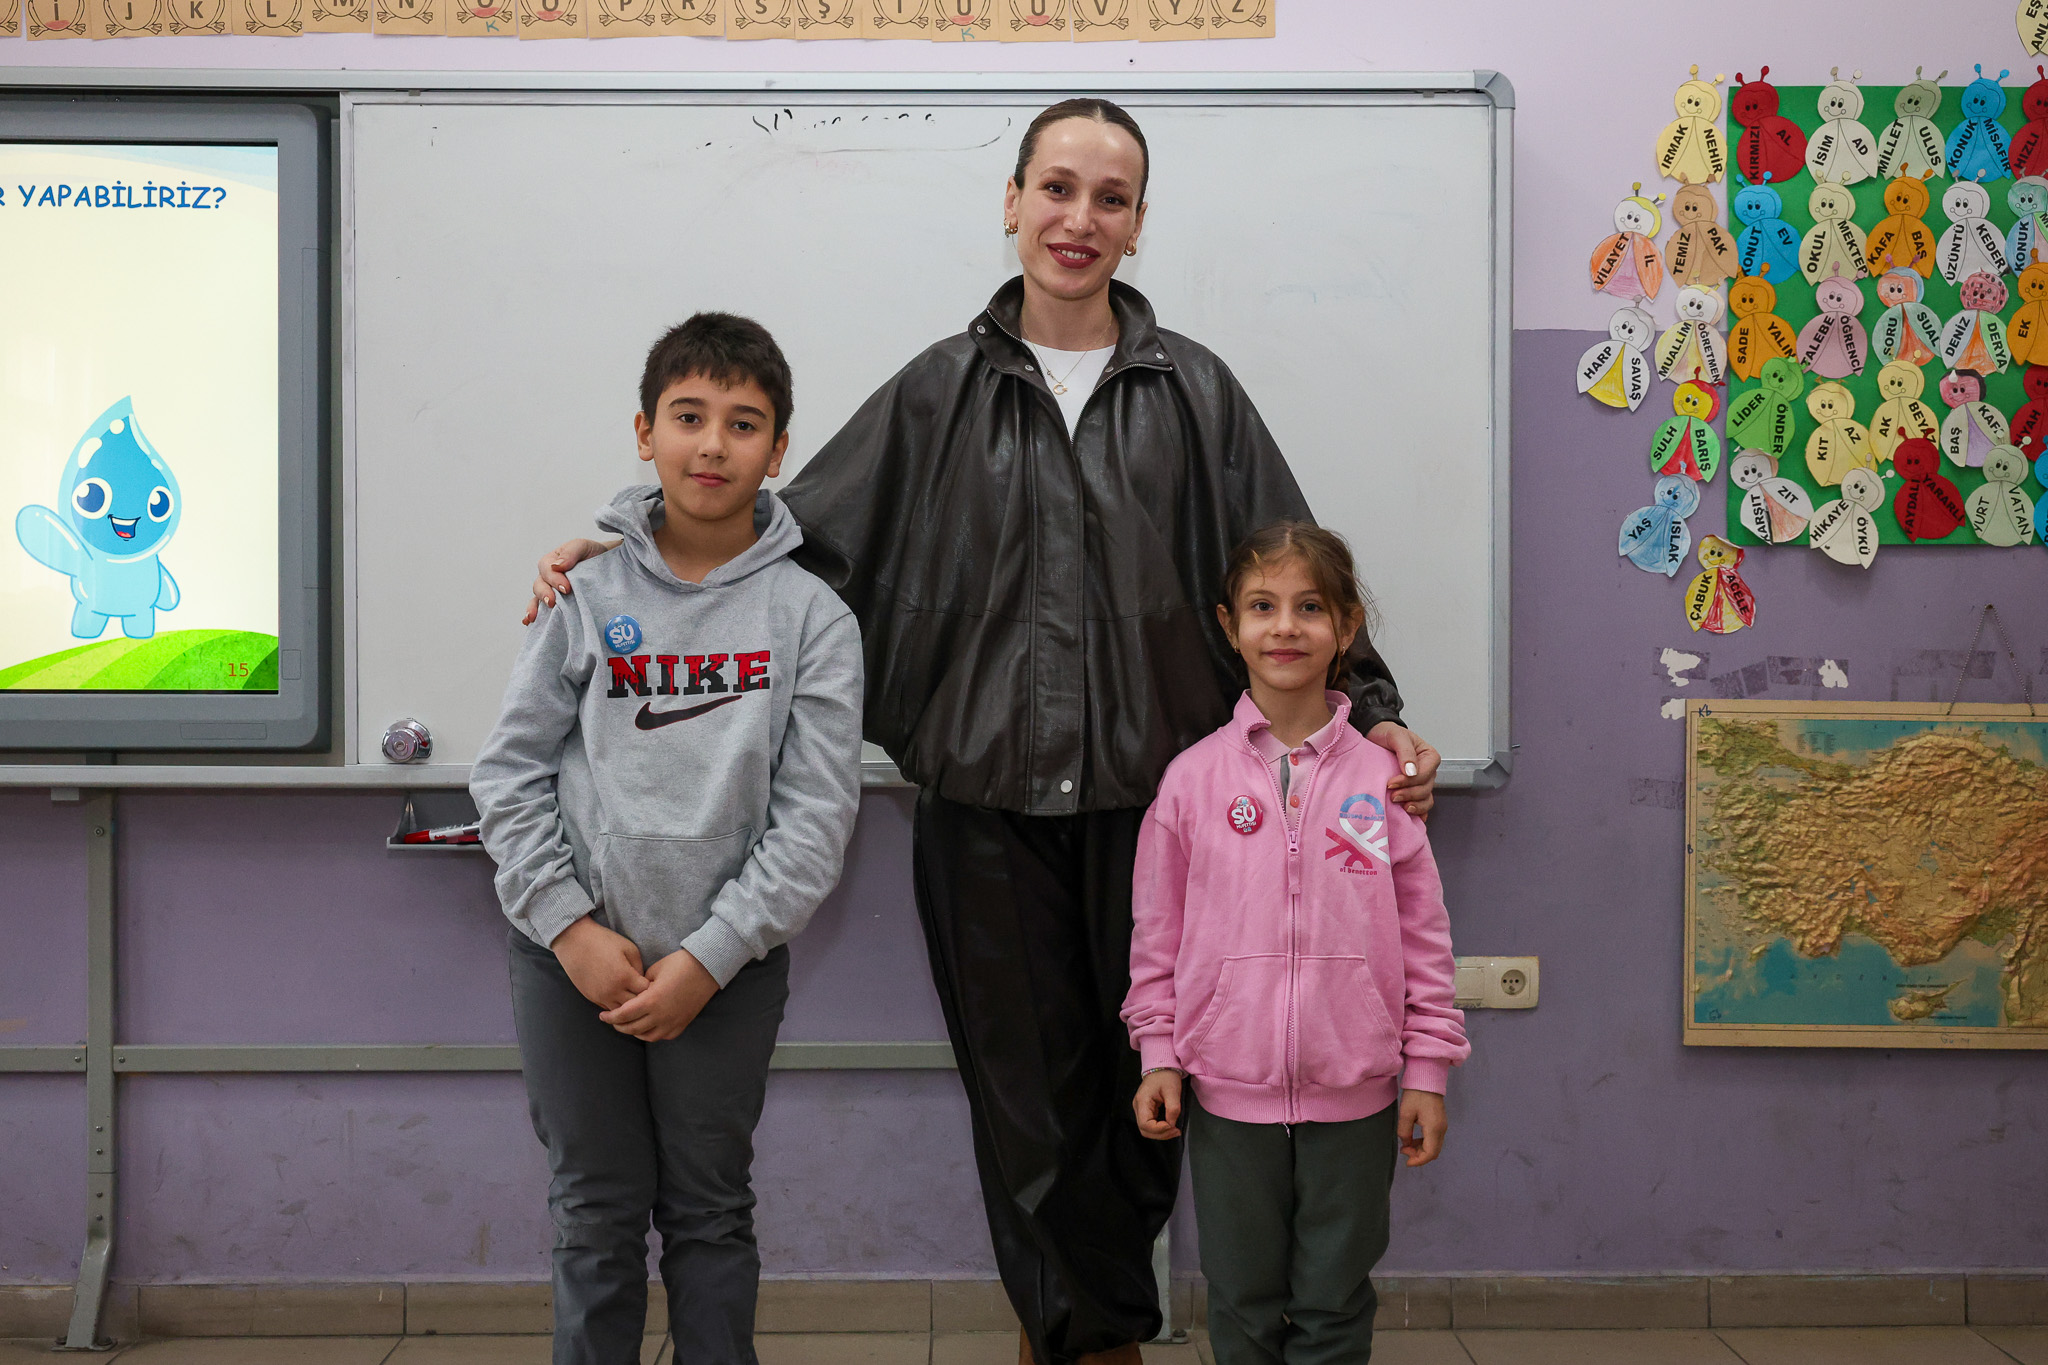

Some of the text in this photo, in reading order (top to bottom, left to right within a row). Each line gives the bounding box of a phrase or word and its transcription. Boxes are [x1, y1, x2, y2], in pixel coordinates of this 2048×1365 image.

[125, 2, 132, 20] J
[190, 0, 204, 18] K
[266, 0, 276, 17] L
[1661, 124, 1688, 170] IRMAK
[1704, 128, 1722, 174] NEHİR
[1750, 125, 1760, 179] KIRMIZI
[1776, 129, 1791, 146] AL
[1812, 135, 1834, 166] İSİM
[1852, 137, 1868, 155] AD
[1879, 120, 1904, 174] MİLLET
[1919, 126, 1942, 166] ULUS
[1948, 119, 1978, 168] KONUK
[2014, 132, 2039, 169] HIZLI
[18, 180, 227, 209] YAPABİLİRİZ?
[1673, 232, 1691, 275] TEMİZ
[1707, 227, 1728, 256] PAK
[1777, 227, 1793, 245] EV
[1807, 231, 1826, 273] OKUL
[1837, 220, 1868, 273] MEKTEP
[1867, 231, 1895, 265] KAFA
[1946, 224, 1965, 281] ÜZÜNTÜ
[1976, 224, 2006, 269] KEDER
[2014, 221, 2029, 271] KONUK
[1594, 232, 1629, 285] VİLAYET
[1737, 327, 1749, 364] SADE
[1800, 315, 1835, 366] TALEBE
[1917, 312, 1940, 347] SUAL
[1945, 317, 1970, 357] DENİZ
[1987, 322, 2008, 368] DERYA
[2018, 319, 2031, 338] EK
[1583, 346, 1612, 379] HARP
[1658, 322, 1692, 377] MUALLİM
[1631, 357, 1641, 400] SAVAŞ
[1732, 392, 1765, 427] LİDER
[1773, 403, 1788, 454] ÖNDER
[1879, 416, 1892, 437] AK
[1978, 405, 2004, 439] KAF
[1653, 426, 1677, 460] SULH
[1817, 437, 1829, 461] KIT
[1845, 426, 1861, 445] AZ
[1950, 427, 1962, 454] BAŞ
[1777, 486, 1799, 504] ZIT
[1922, 472, 1965, 522] YARARLI
[2009, 485, 2031, 535] VATAN
[1628, 518, 1652, 540] YAŞ
[1811, 499, 1849, 541] HİKAYE
[1973, 496, 1990, 533] YURT
[1668, 521, 1681, 563] ISLAK
[1857, 517, 1870, 555] ÖYKÜ
[1690, 573, 1713, 621] ÇABUK
[1727, 575, 1749, 614] ACELE
[228, 663, 250, 677] 15
[607, 650, 770, 698] NIKE
